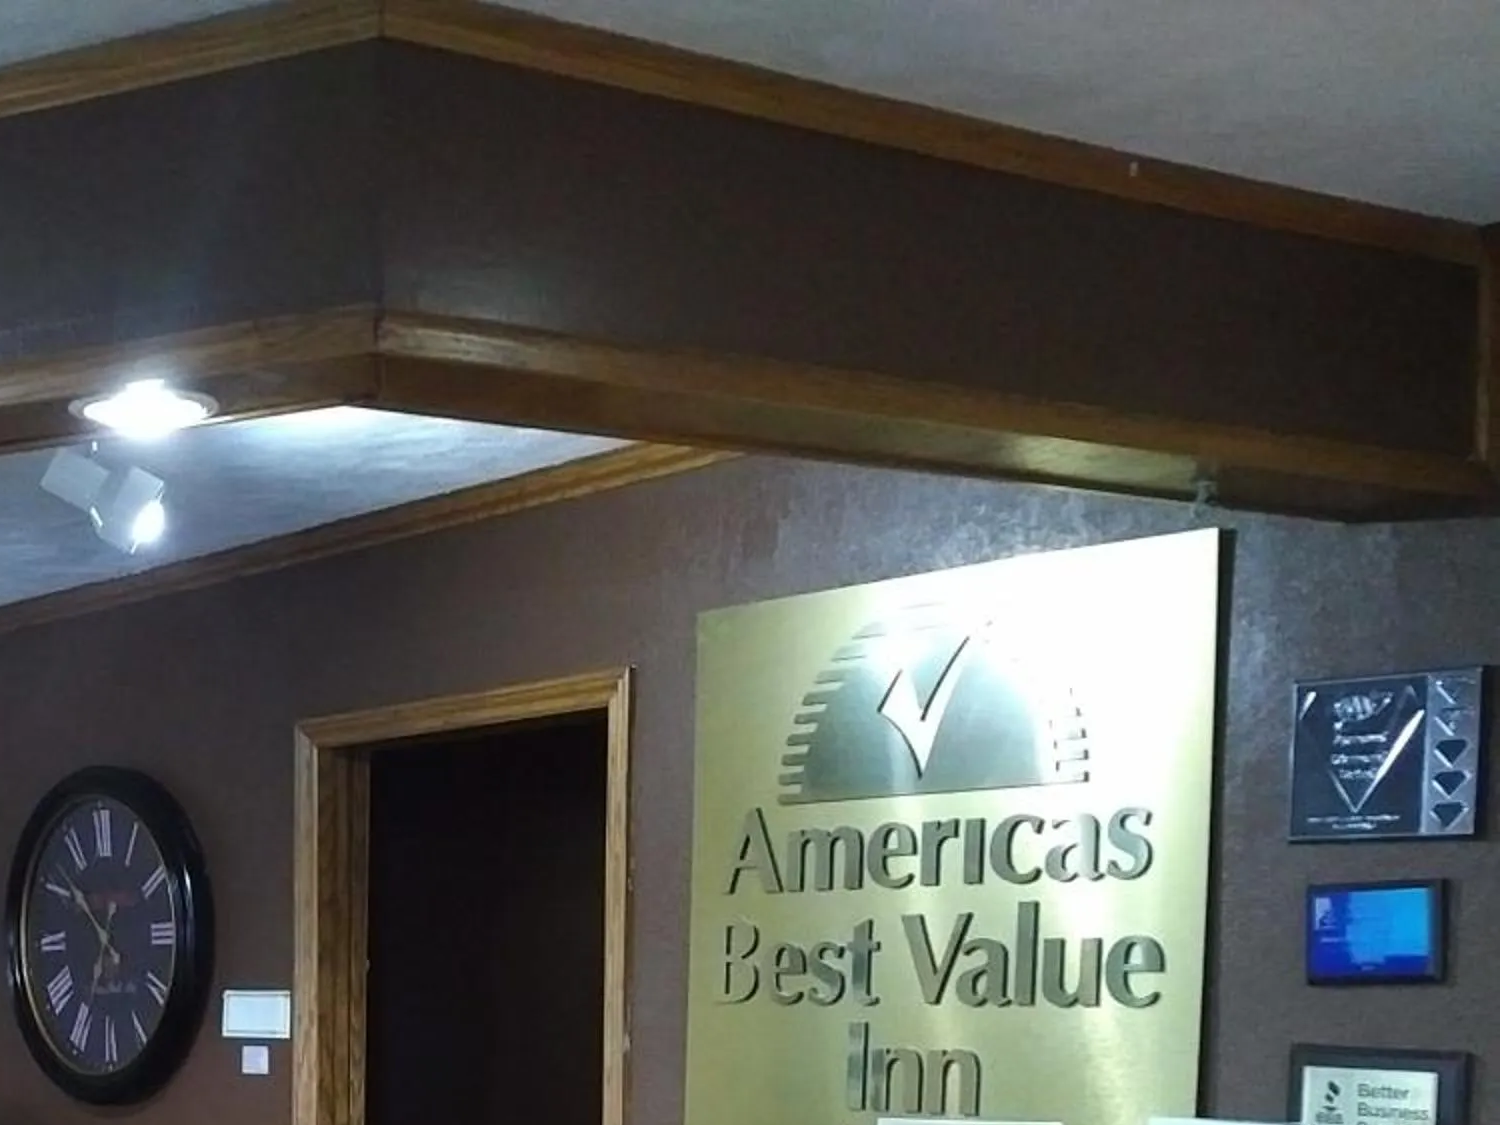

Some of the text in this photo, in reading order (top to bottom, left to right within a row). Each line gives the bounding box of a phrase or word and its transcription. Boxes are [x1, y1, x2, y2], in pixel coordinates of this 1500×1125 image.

[726, 805, 1154, 895] Americas
[721, 901, 1169, 1009] Best Value
[846, 1021, 982, 1117] Inn
[1357, 1082, 1410, 1100] Better
[1357, 1101, 1429, 1121] Business
